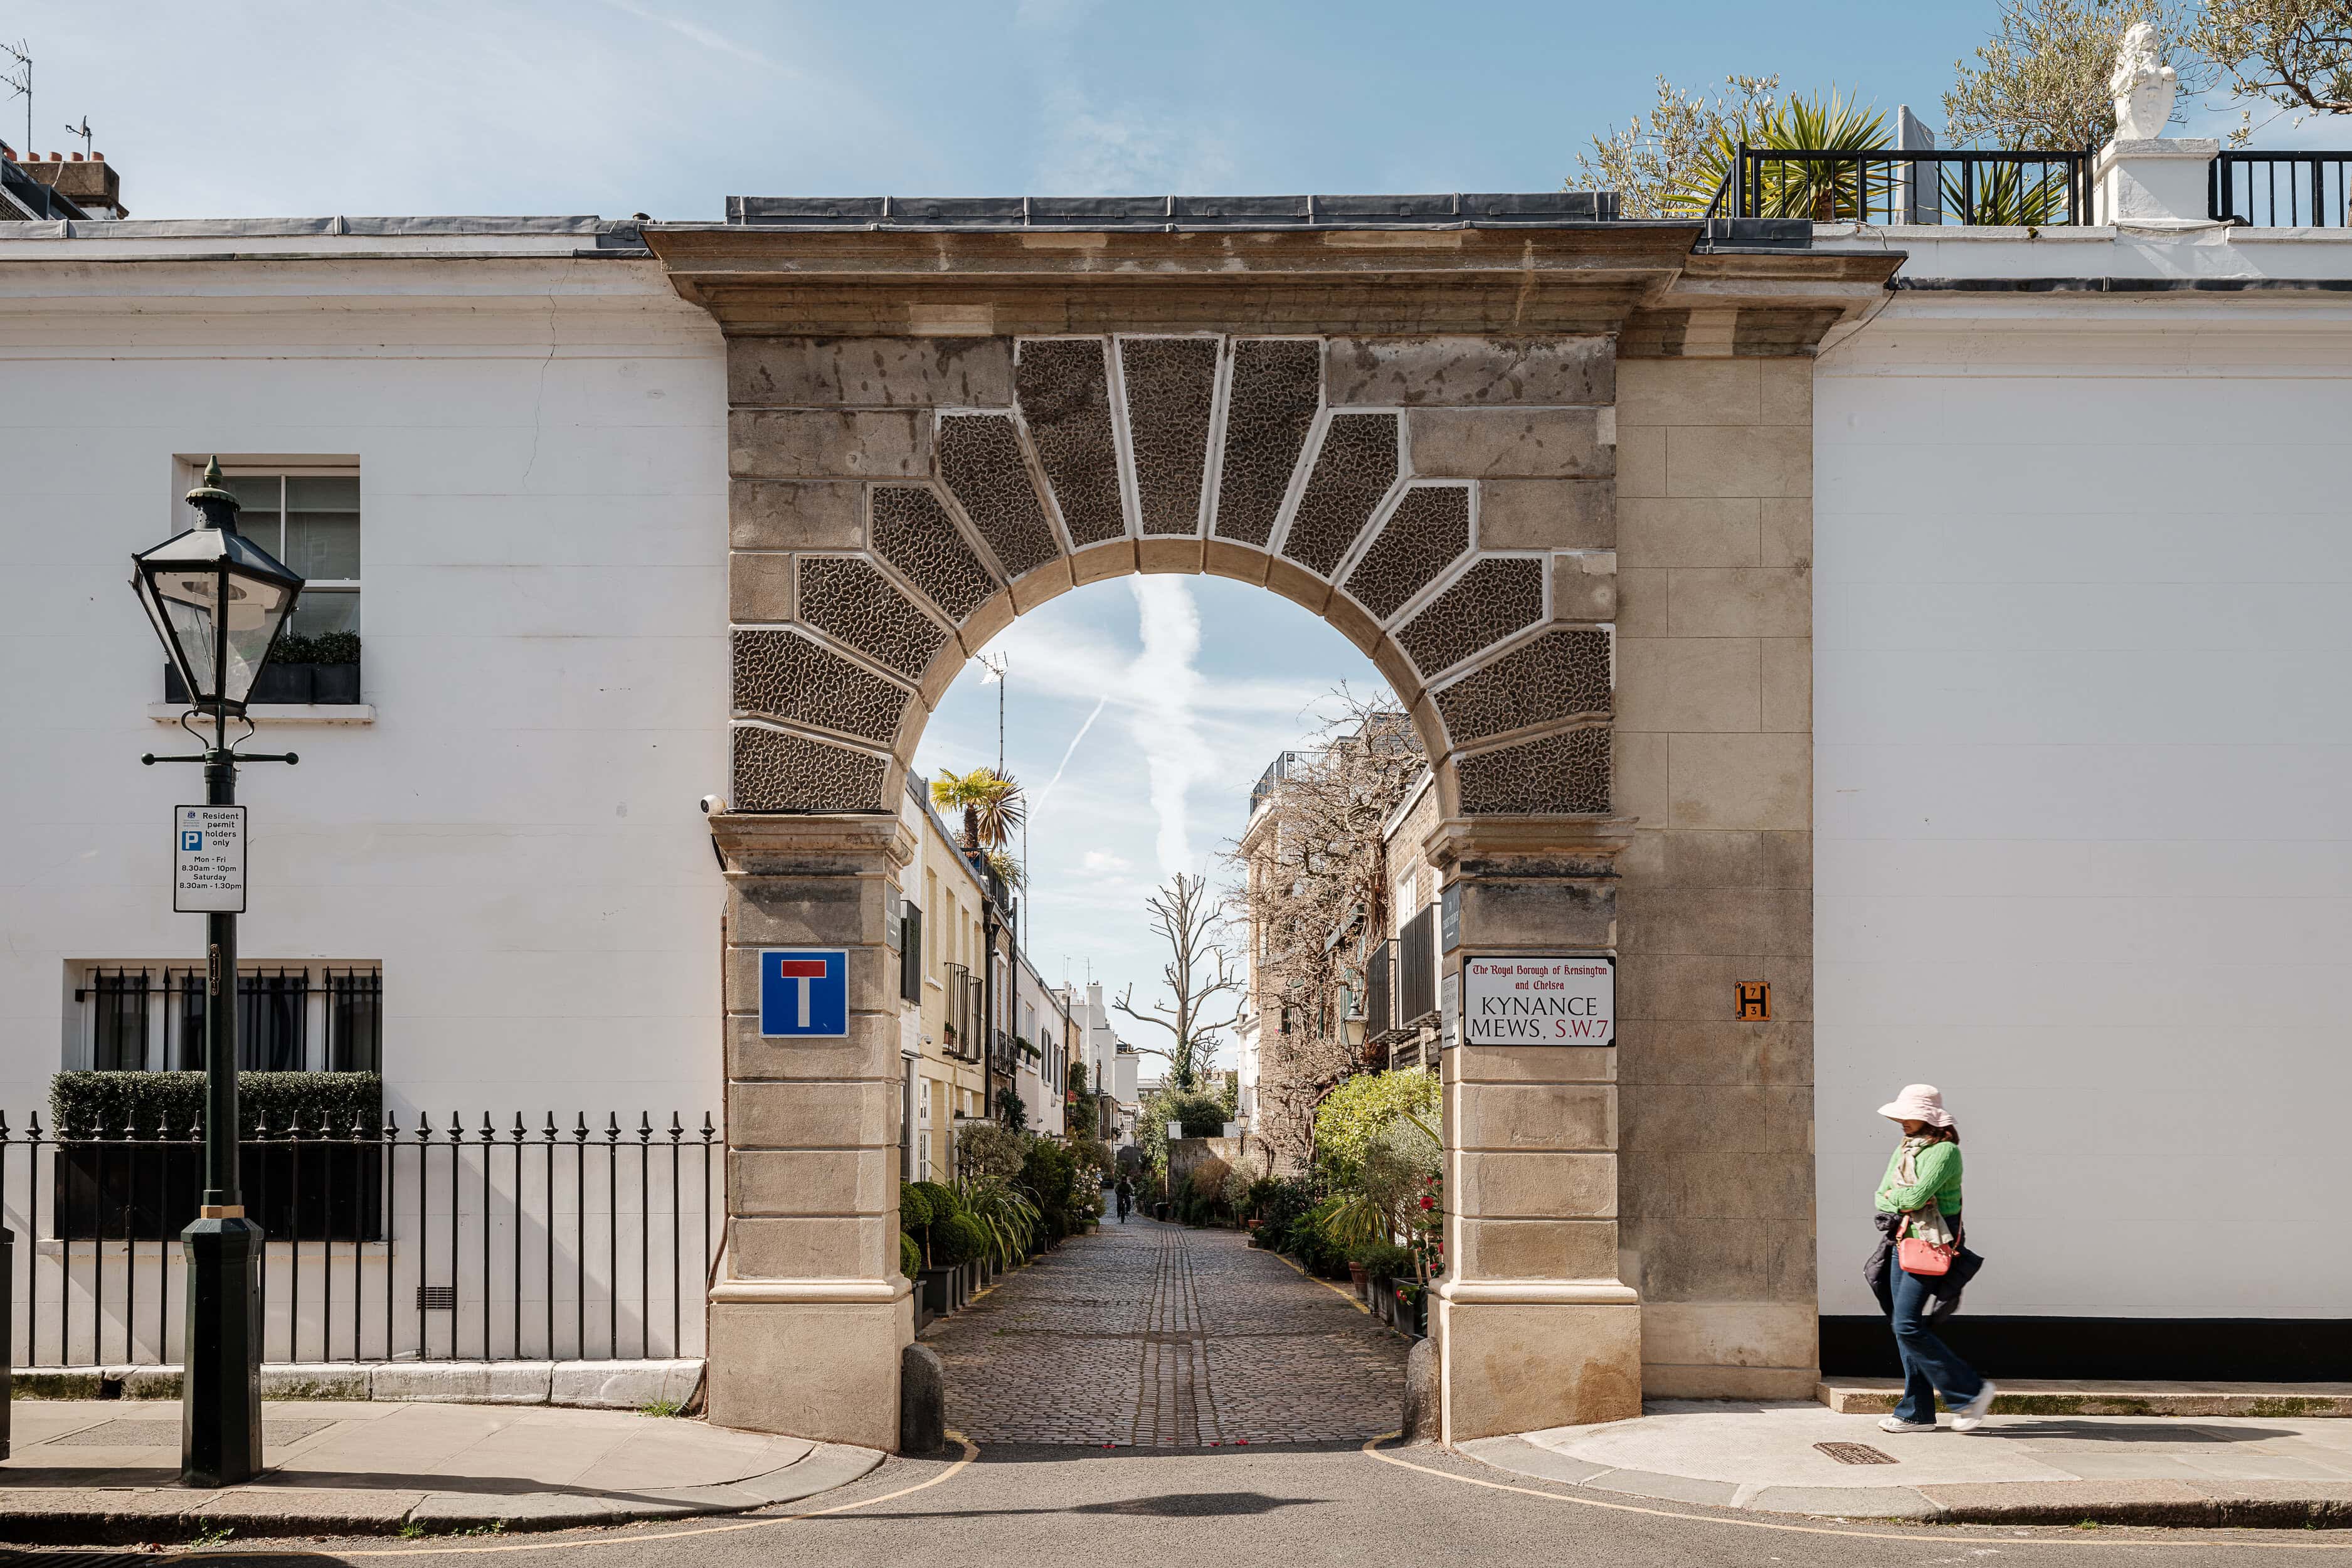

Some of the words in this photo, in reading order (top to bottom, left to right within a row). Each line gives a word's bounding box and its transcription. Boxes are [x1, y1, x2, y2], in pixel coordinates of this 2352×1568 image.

[185, 832, 199, 849] P
[1473, 965, 1488, 975] The
[1490, 965, 1513, 977] Royal
[1517, 965, 1549, 977] Borough
[1552, 965, 1560, 975] of
[1564, 965, 1608, 977] Kensington
[1515, 980, 1529, 989] and
[1533, 980, 1564, 990] Chelsea
[1750, 988, 1756, 996] 7
[1482, 997, 1597, 1015] KYNANCE
[1740, 986, 1766, 1017] H
[1751, 1007, 1757, 1015] 3
[1471, 1019, 1546, 1040] MEWS,
[1555, 1019, 1608, 1037] S.W.7
